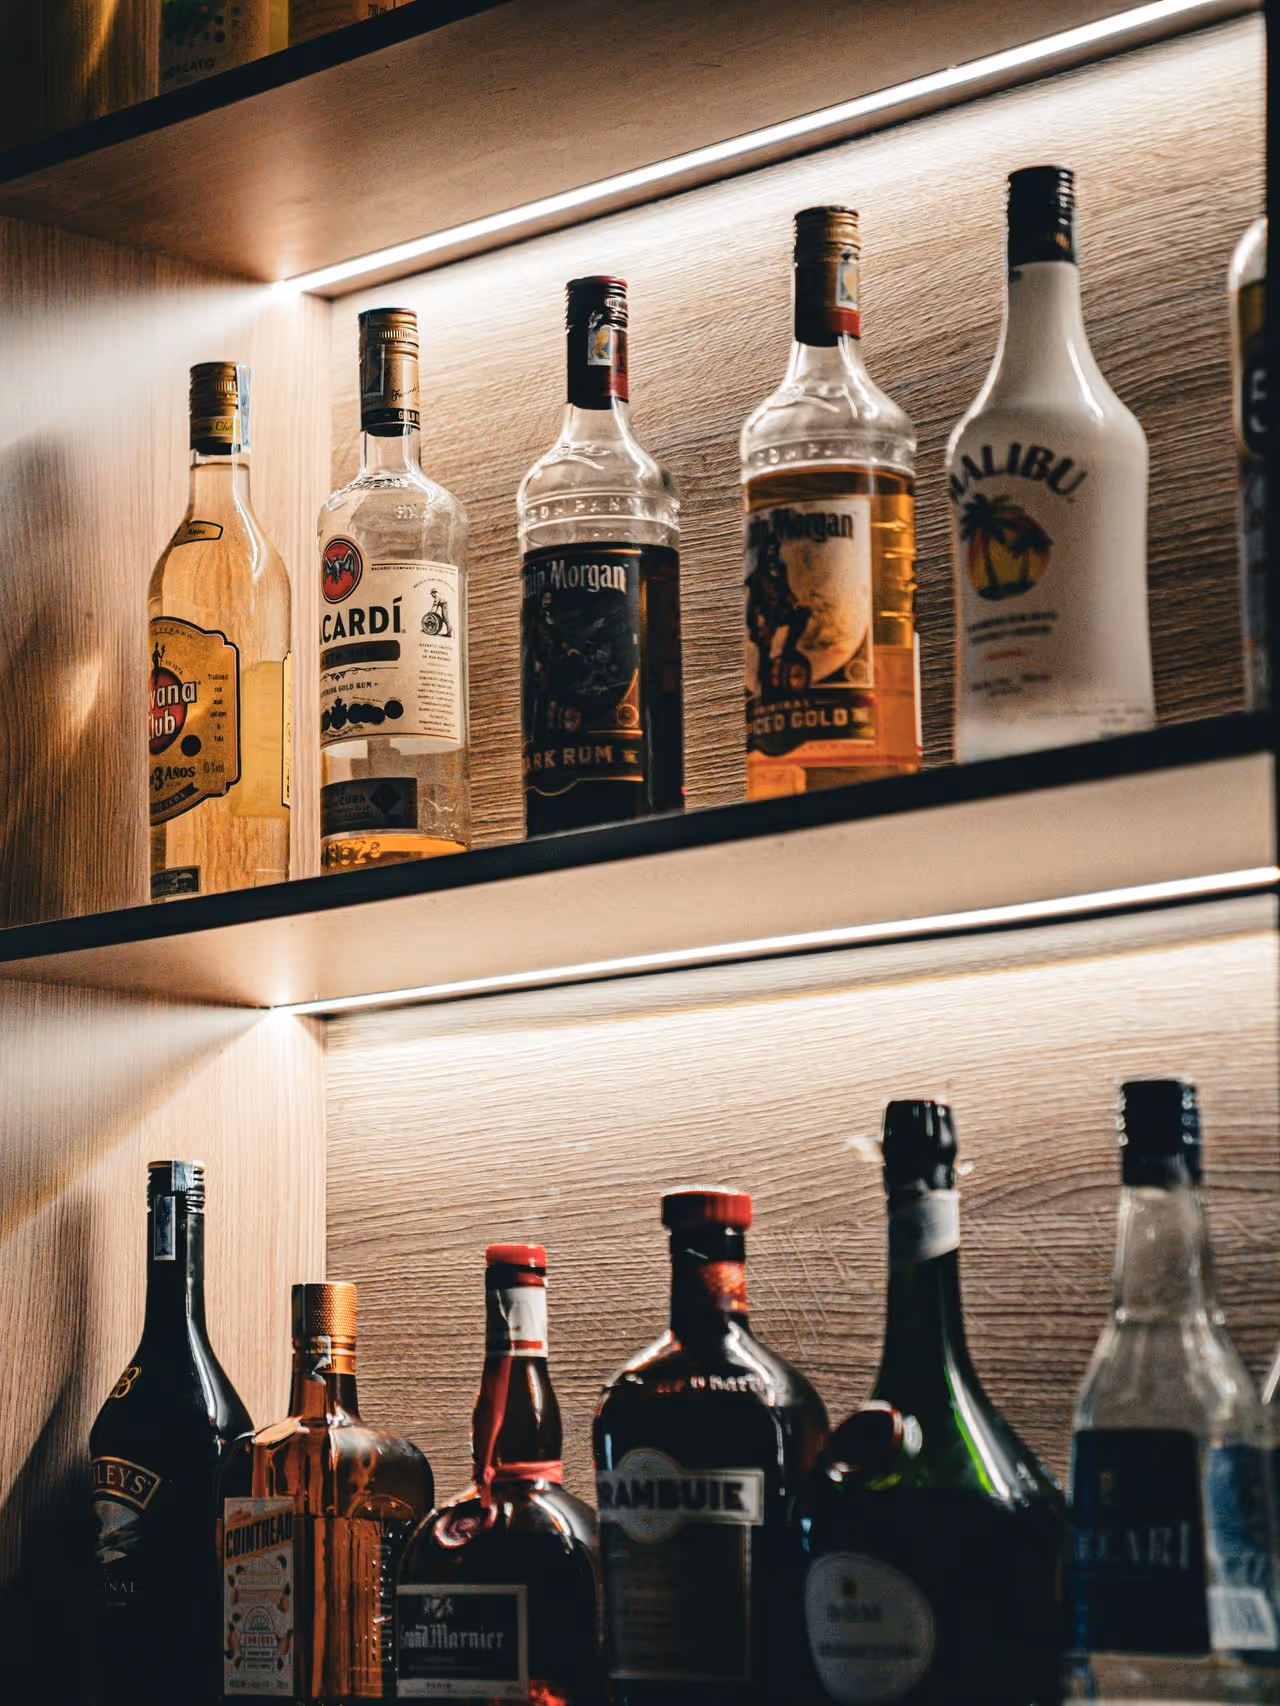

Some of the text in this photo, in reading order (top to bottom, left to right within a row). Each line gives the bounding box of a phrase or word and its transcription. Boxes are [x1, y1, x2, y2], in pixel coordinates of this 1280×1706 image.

[398, 410, 416, 422] GOLD
[548, 559, 627, 595] Morgan
[320, 595, 403, 645] CARDÍ
[338, 683, 354, 693] GOLD
[356, 681, 372, 690] RUM
[149, 709, 176, 740] lub
[791, 708, 849, 728] GOLD
[563, 744, 614, 767] RUM
[154, 766, 164, 791] 3
[429, 1623, 504, 1650] Marnier
